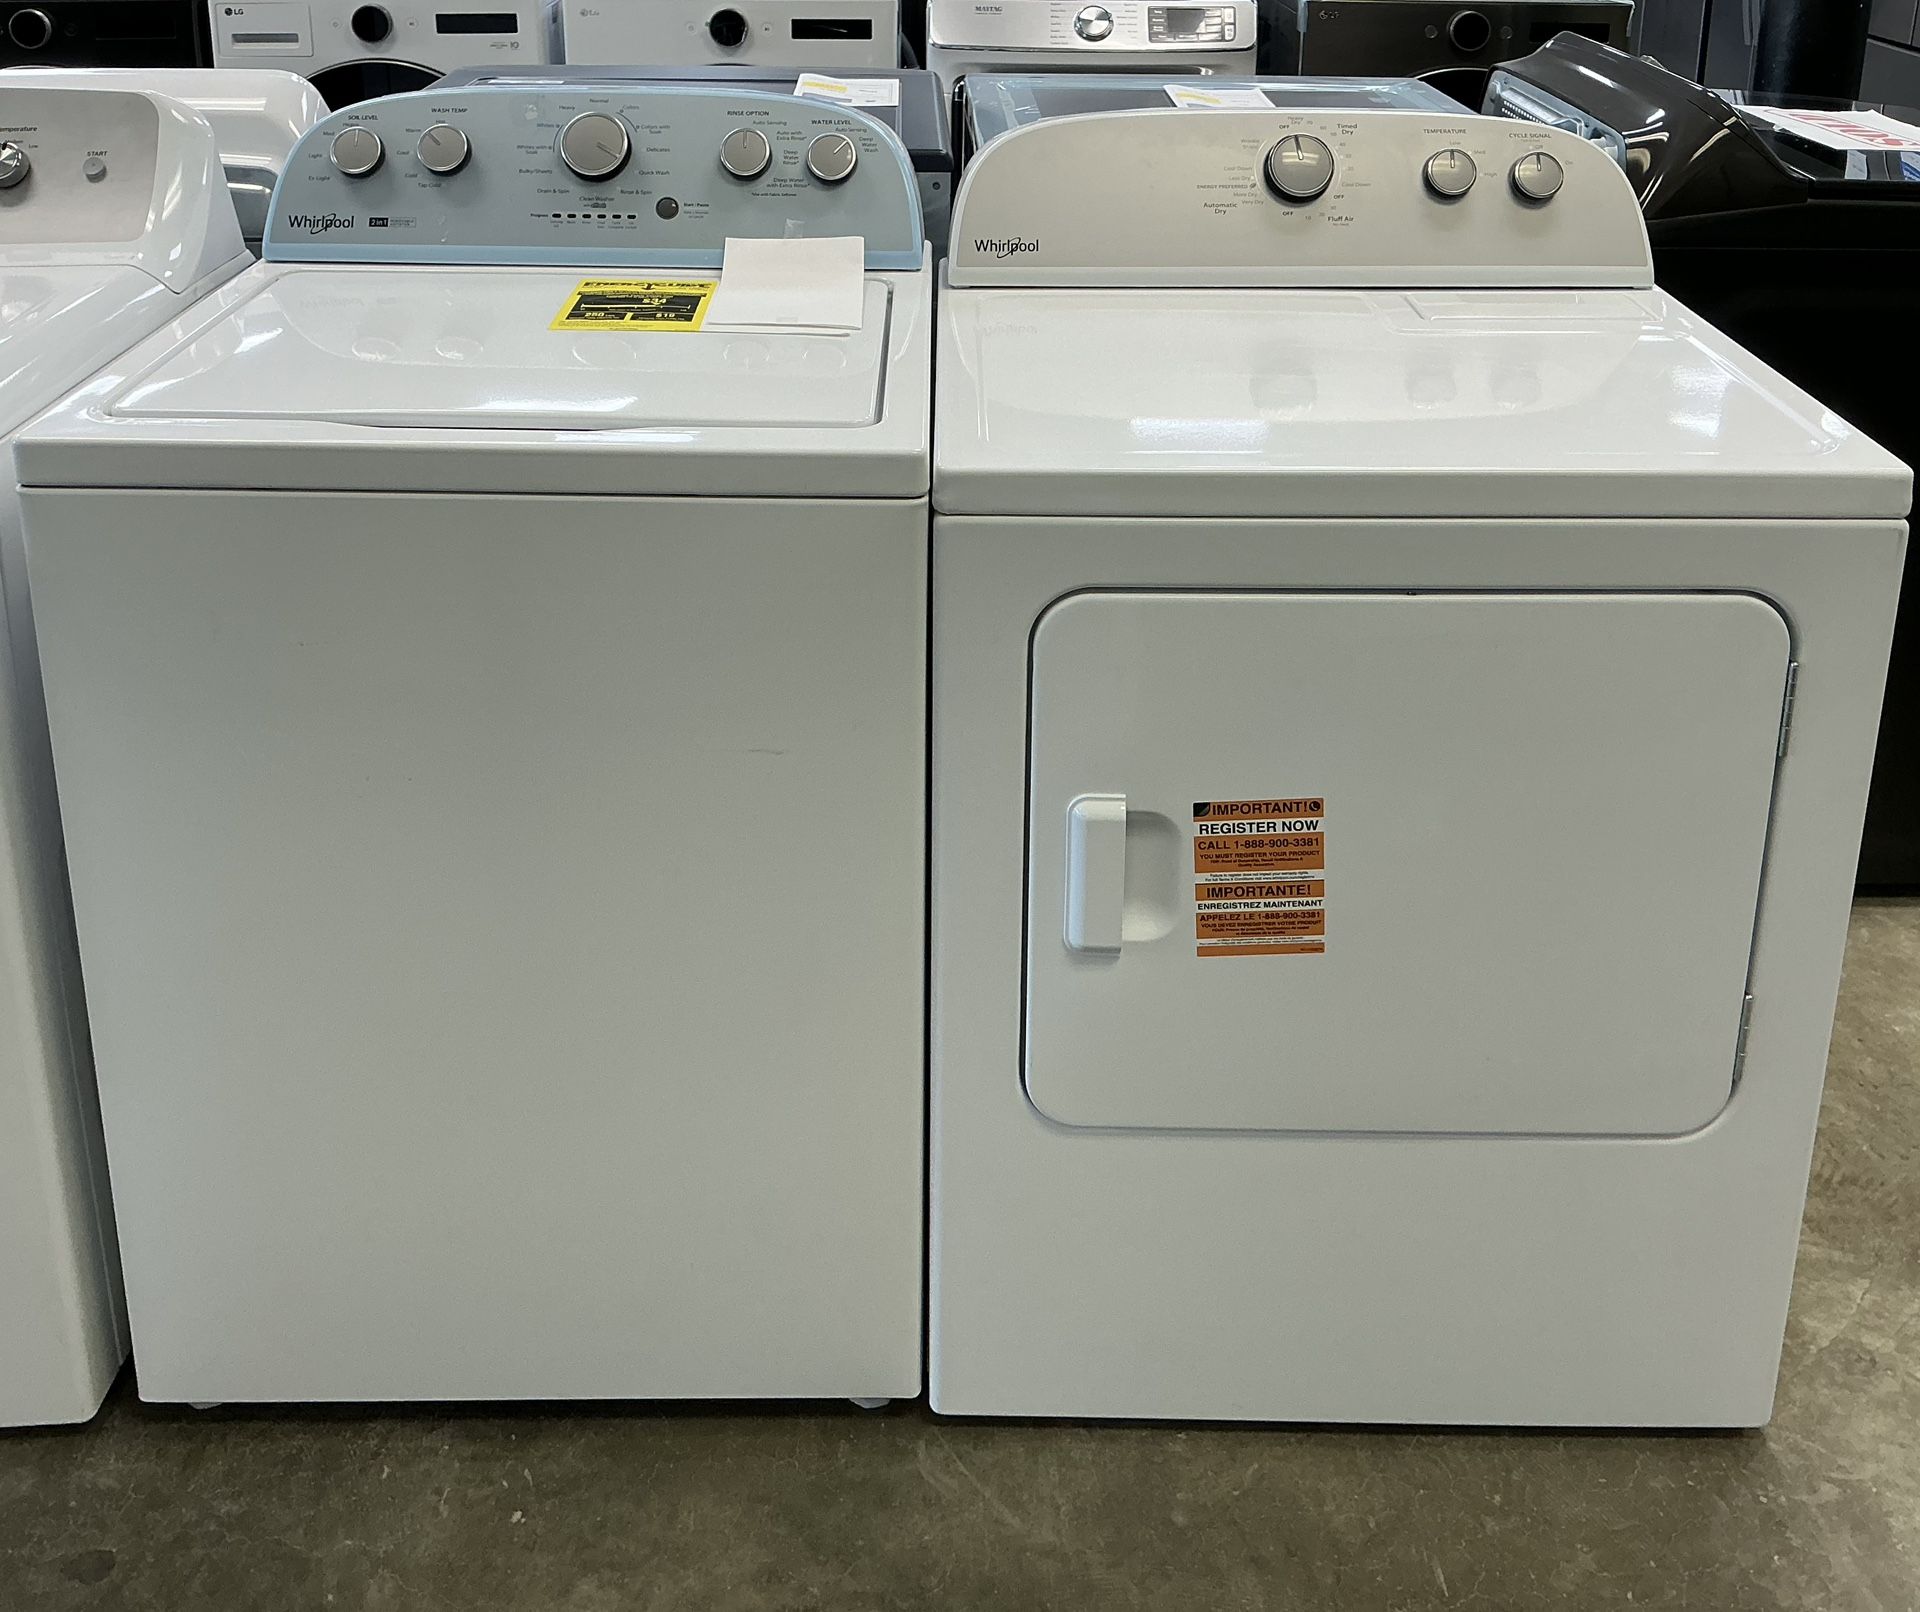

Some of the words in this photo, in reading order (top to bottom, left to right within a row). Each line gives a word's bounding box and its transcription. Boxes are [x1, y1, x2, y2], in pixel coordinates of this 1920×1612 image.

[288, 213, 354, 234] Whirlpool
[974, 237, 1039, 258] Whirlpool
[1212, 801, 1308, 816] IMPORTANT!
[1199, 822, 1277, 835] REGISTER
[1282, 820, 1319, 832] NOW
[1198, 840, 1230, 850] CALL
[1234, 838, 1320, 850] 1-888-900-3381
[1206, 884, 1311, 898] IMPORTANTE!
[1198, 902, 1262, 910] ENREGISTREZ
[1263, 900, 1323, 908] MAINTENANT
[1200, 914, 1241, 922] APPELEZ
[1258, 911, 1320, 920] 1-888-900-3381
